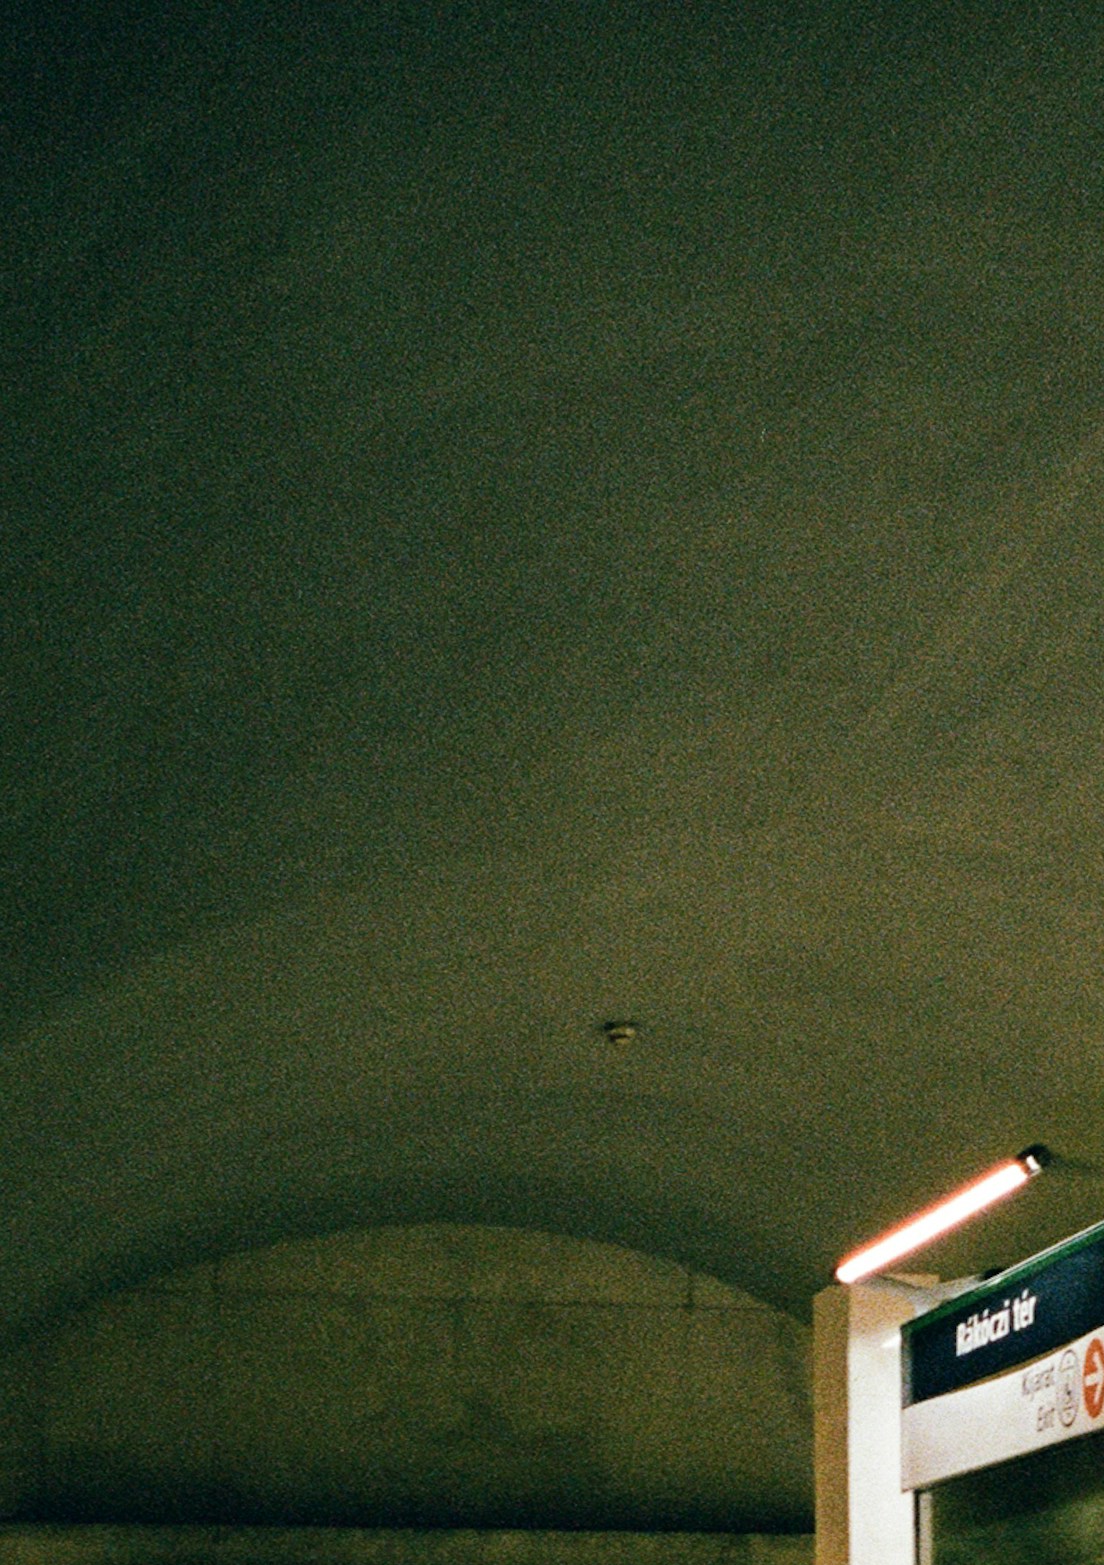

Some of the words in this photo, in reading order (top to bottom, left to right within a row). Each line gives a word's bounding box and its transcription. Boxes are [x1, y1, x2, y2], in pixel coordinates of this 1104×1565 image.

[956, 1299, 1010, 1357] Rákóczi
[1013, 1289, 1037, 1331] tér
[1037, 1406, 1055, 1432] Exit
